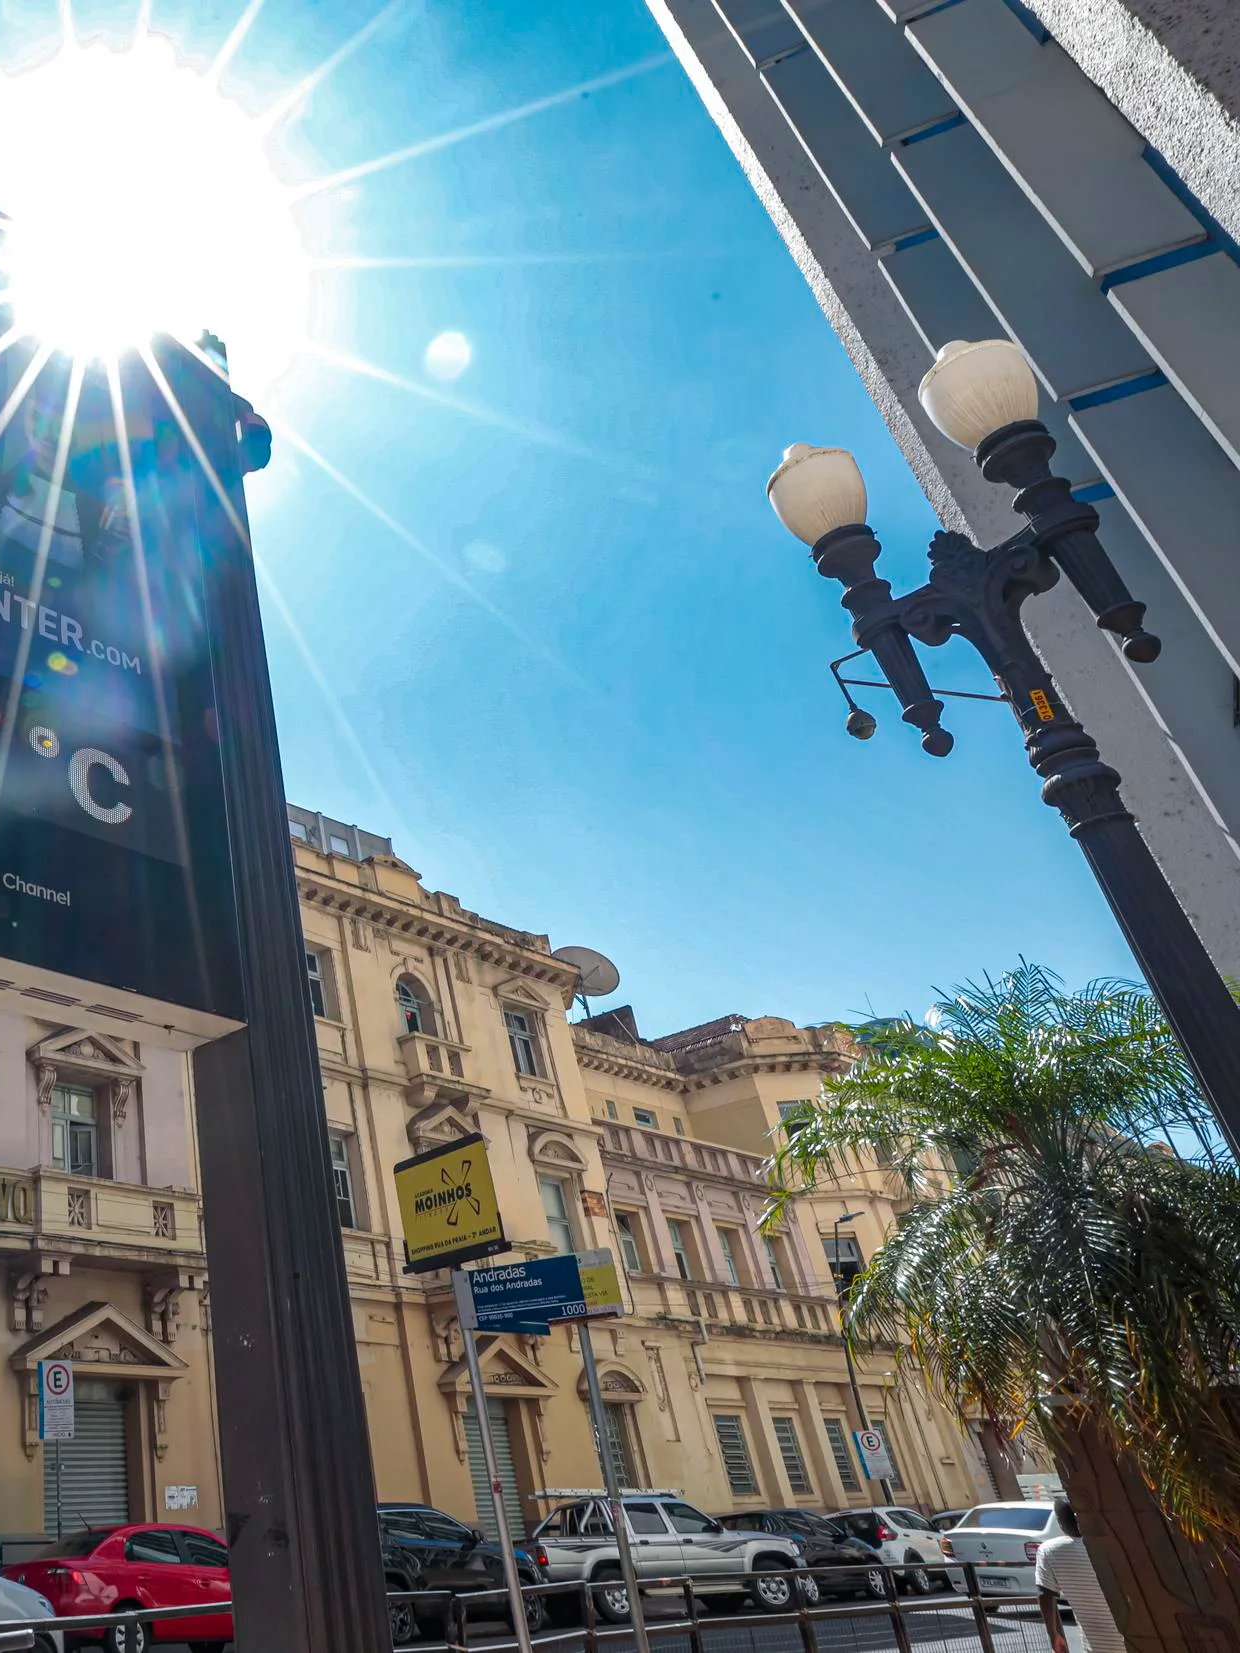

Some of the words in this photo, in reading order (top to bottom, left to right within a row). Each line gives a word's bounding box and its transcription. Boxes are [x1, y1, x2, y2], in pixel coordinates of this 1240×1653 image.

[3, 872, 71, 906] Channel
[415, 1182, 472, 1214] MOINHOS
[473, 1266, 526, 1284] Andradas
[473, 1285, 489, 1295] Rua
[490, 1284, 504, 1293] dos
[506, 1278, 543, 1291] Andradas
[561, 1304, 586, 1316] 1000
[53, 1371, 63, 1389] E
[866, 1436, 875, 1447] E
